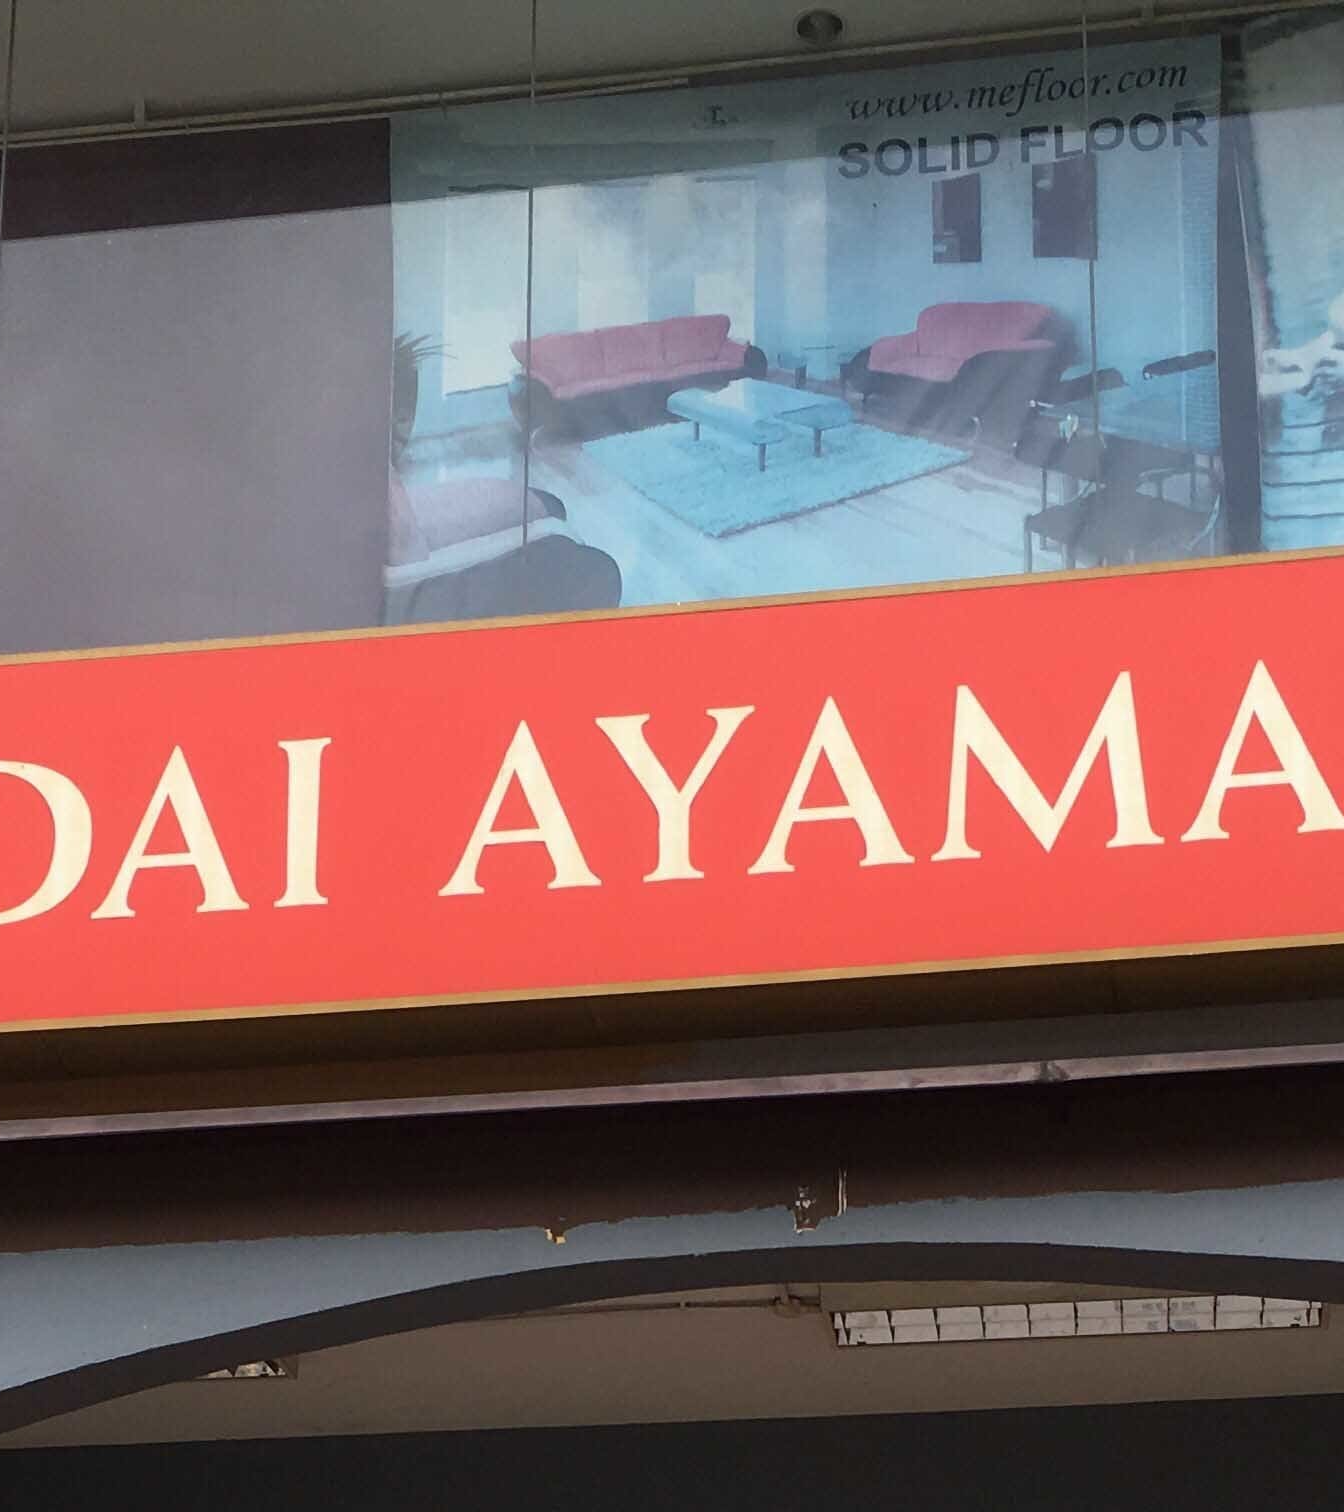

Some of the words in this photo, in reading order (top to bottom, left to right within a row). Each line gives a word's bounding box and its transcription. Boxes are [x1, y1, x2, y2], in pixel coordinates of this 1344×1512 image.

[847, 64, 1187, 120] www.mefloor.com
[838, 132, 999, 178] SOLID
[1021, 110, 1208, 163] FLOOR
